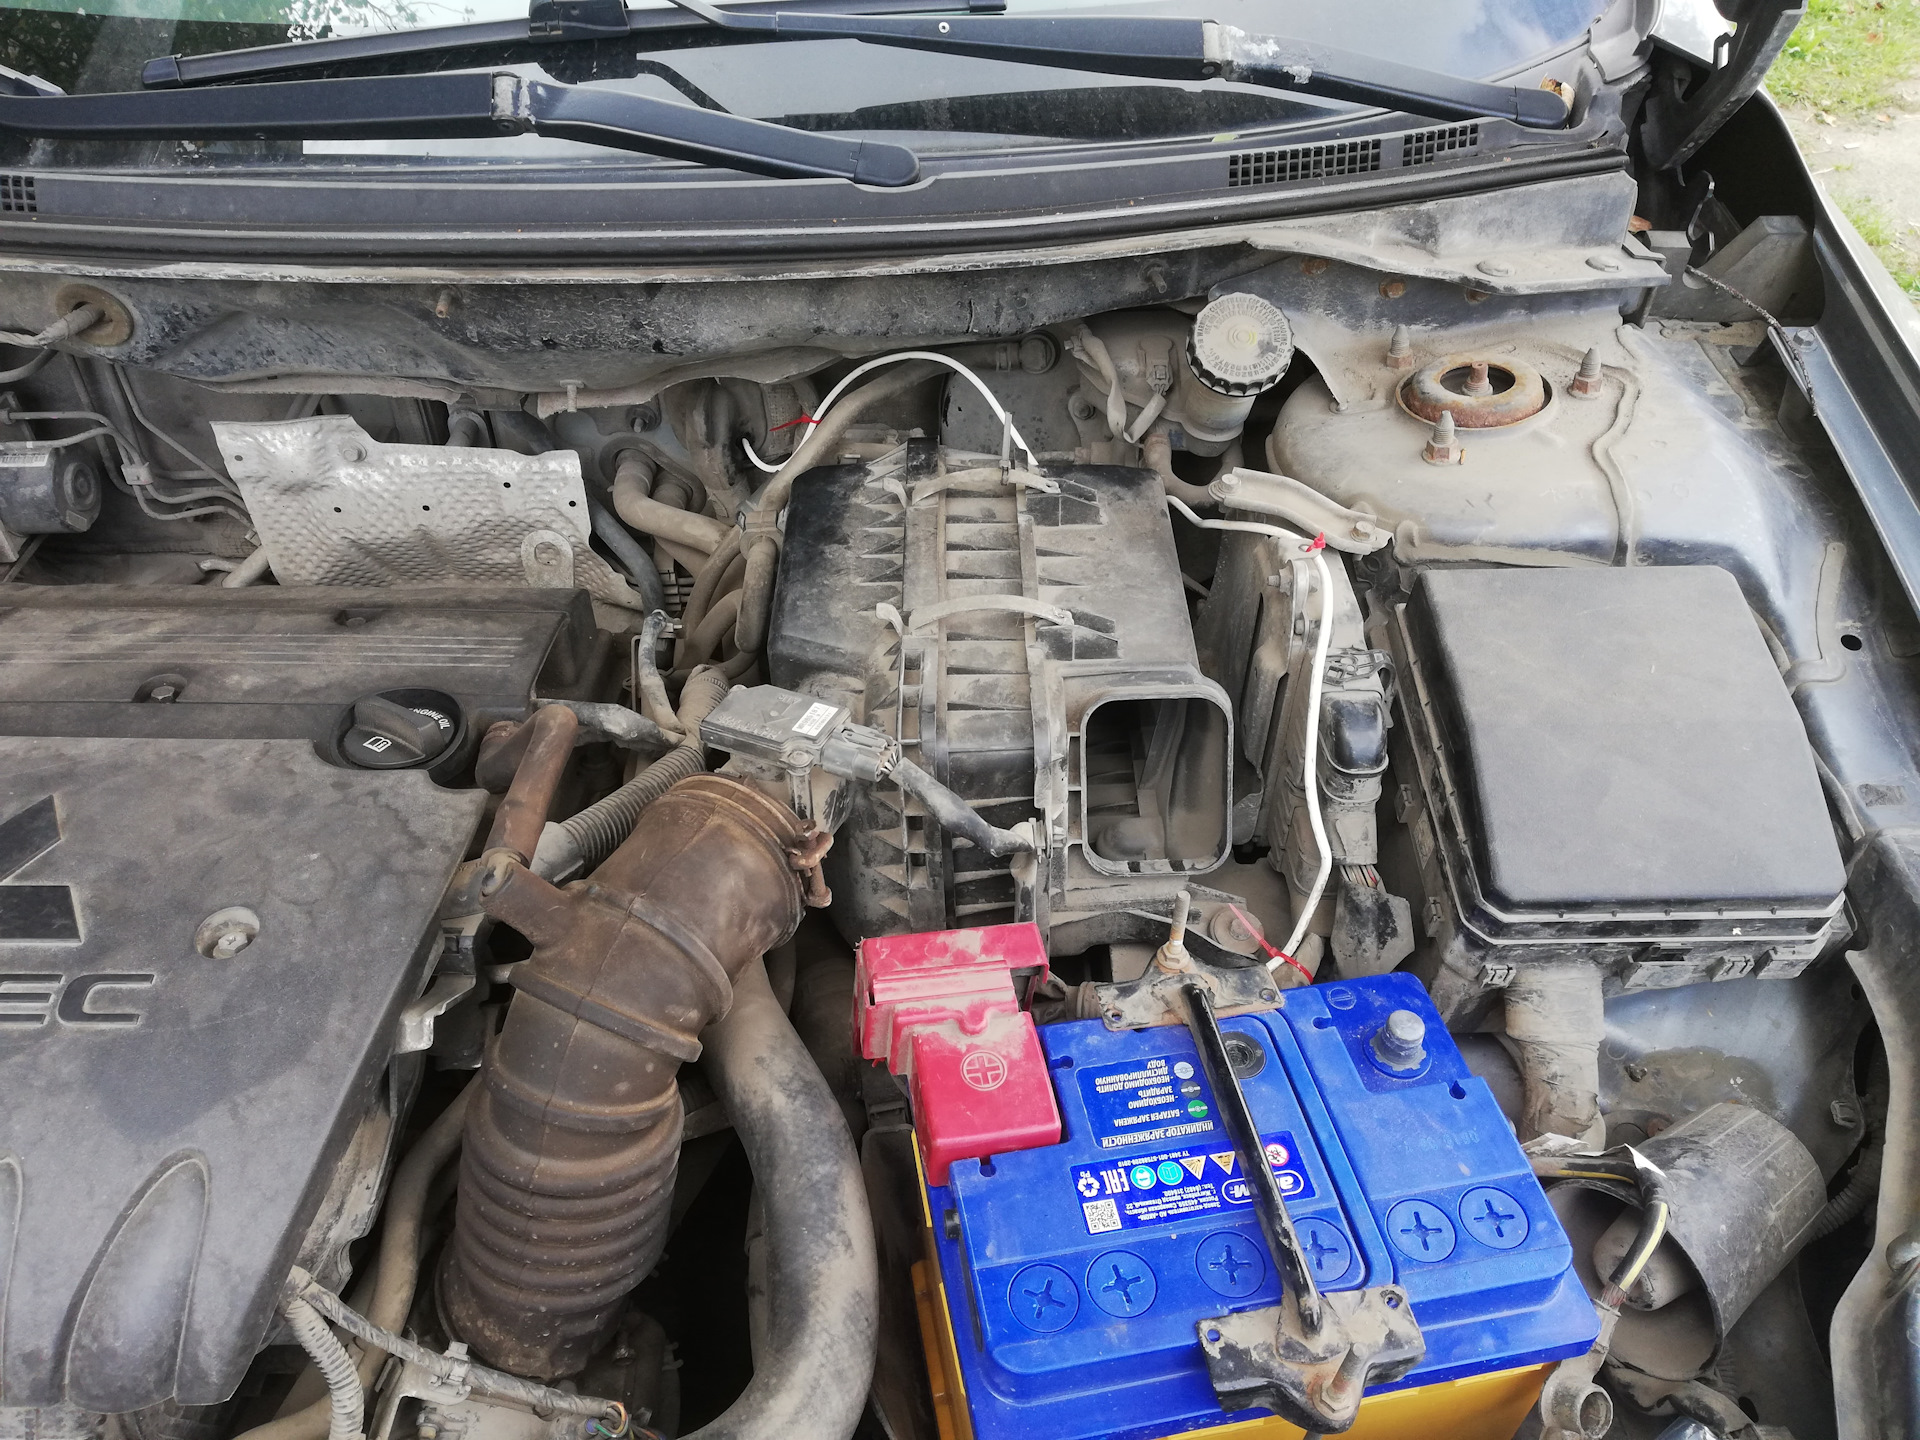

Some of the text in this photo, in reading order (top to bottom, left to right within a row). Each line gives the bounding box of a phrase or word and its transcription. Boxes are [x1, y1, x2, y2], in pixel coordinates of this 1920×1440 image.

[1259, 301, 1280, 319] BEFORE
[409, 708, 450, 729] NGINE OIL
[1147, 1059, 1165, 1069] ВОДУ
[1095, 1066, 1168, 1085] ДИСТИЛЛИРОВАННУЮ
[1124, 1075, 1170, 1089] НЕОБХОДИМО
[1096, 1083, 1124, 1094] ДОЛИТЬ
[1138, 1085, 1173, 1097] ЗАРЯДИТЬ
[1128, 1094, 1174, 1109] НЕОБХОДИМО
[1114, 1114, 1150, 1127] ЗАРЯЖЕНА
[1151, 1109, 1179, 1121] БАТАРЕЯ
[1102, 1121, 1213, 1148] ИНДИКАТОР ЗАРЯЖЕННОСТИ
